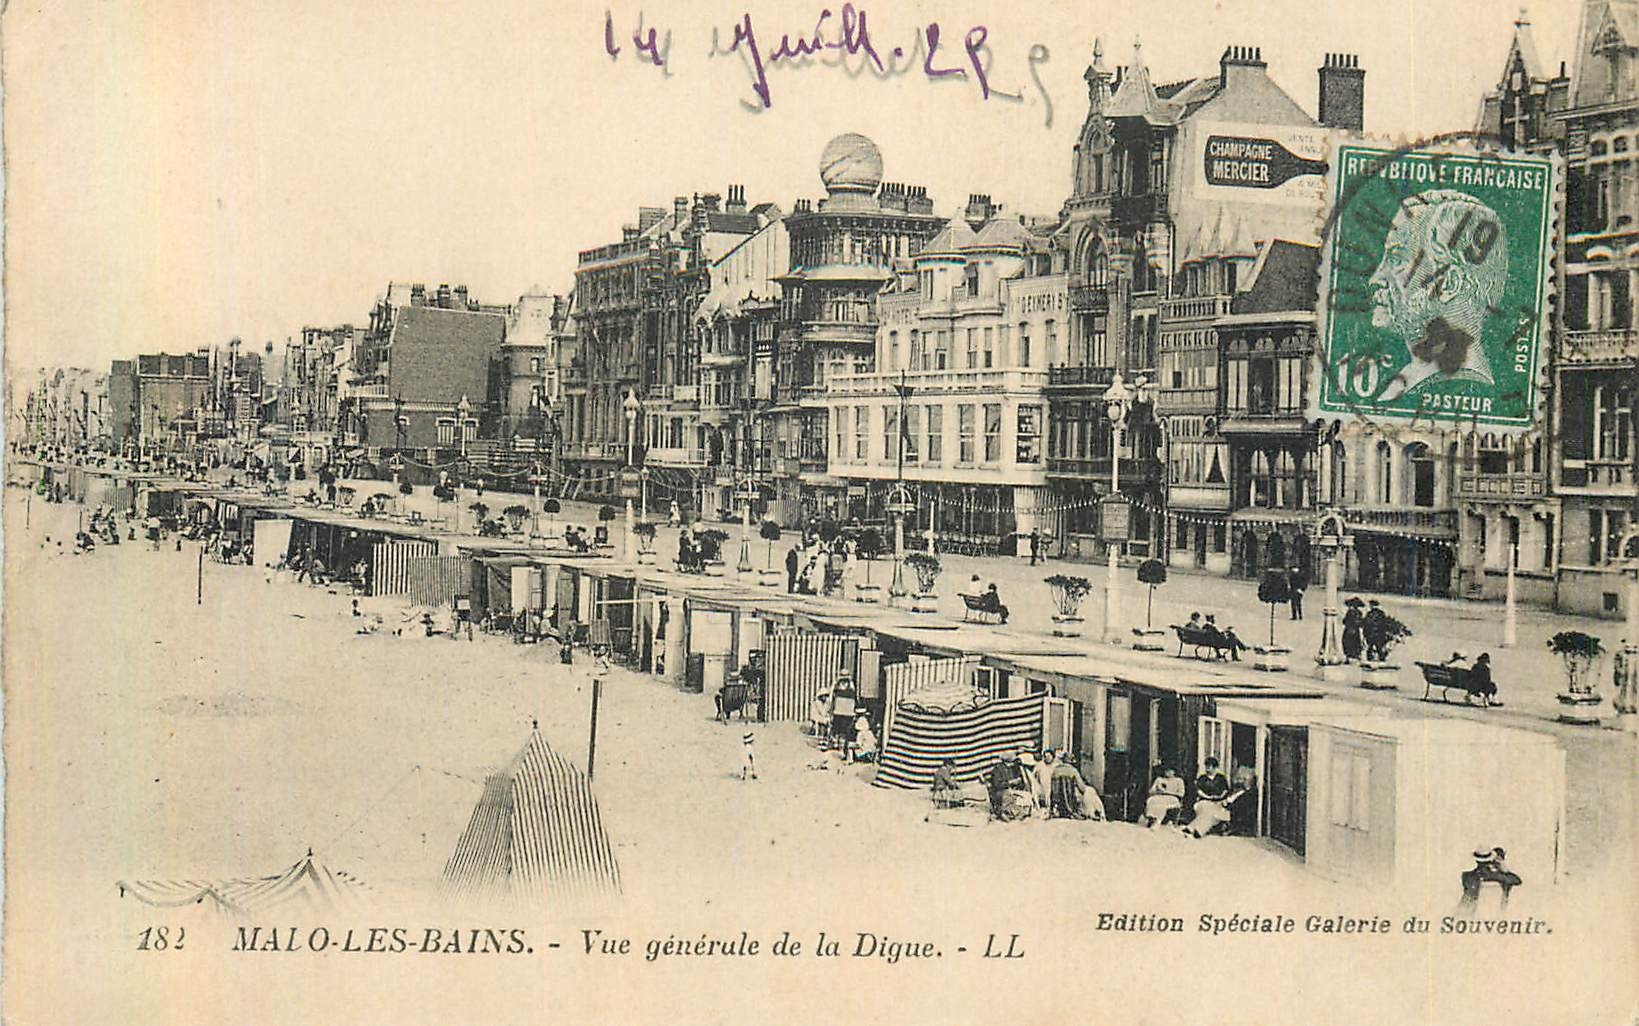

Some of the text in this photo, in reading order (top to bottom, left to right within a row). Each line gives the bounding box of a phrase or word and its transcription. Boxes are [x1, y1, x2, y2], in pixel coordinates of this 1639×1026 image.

[1209, 141, 1273, 160] CHAMPAGNE
[1213, 160, 1270, 182] MERCIER
[1514, 317, 1531, 373] POSTS
[1422, 393, 1493, 412] PASTEUR
